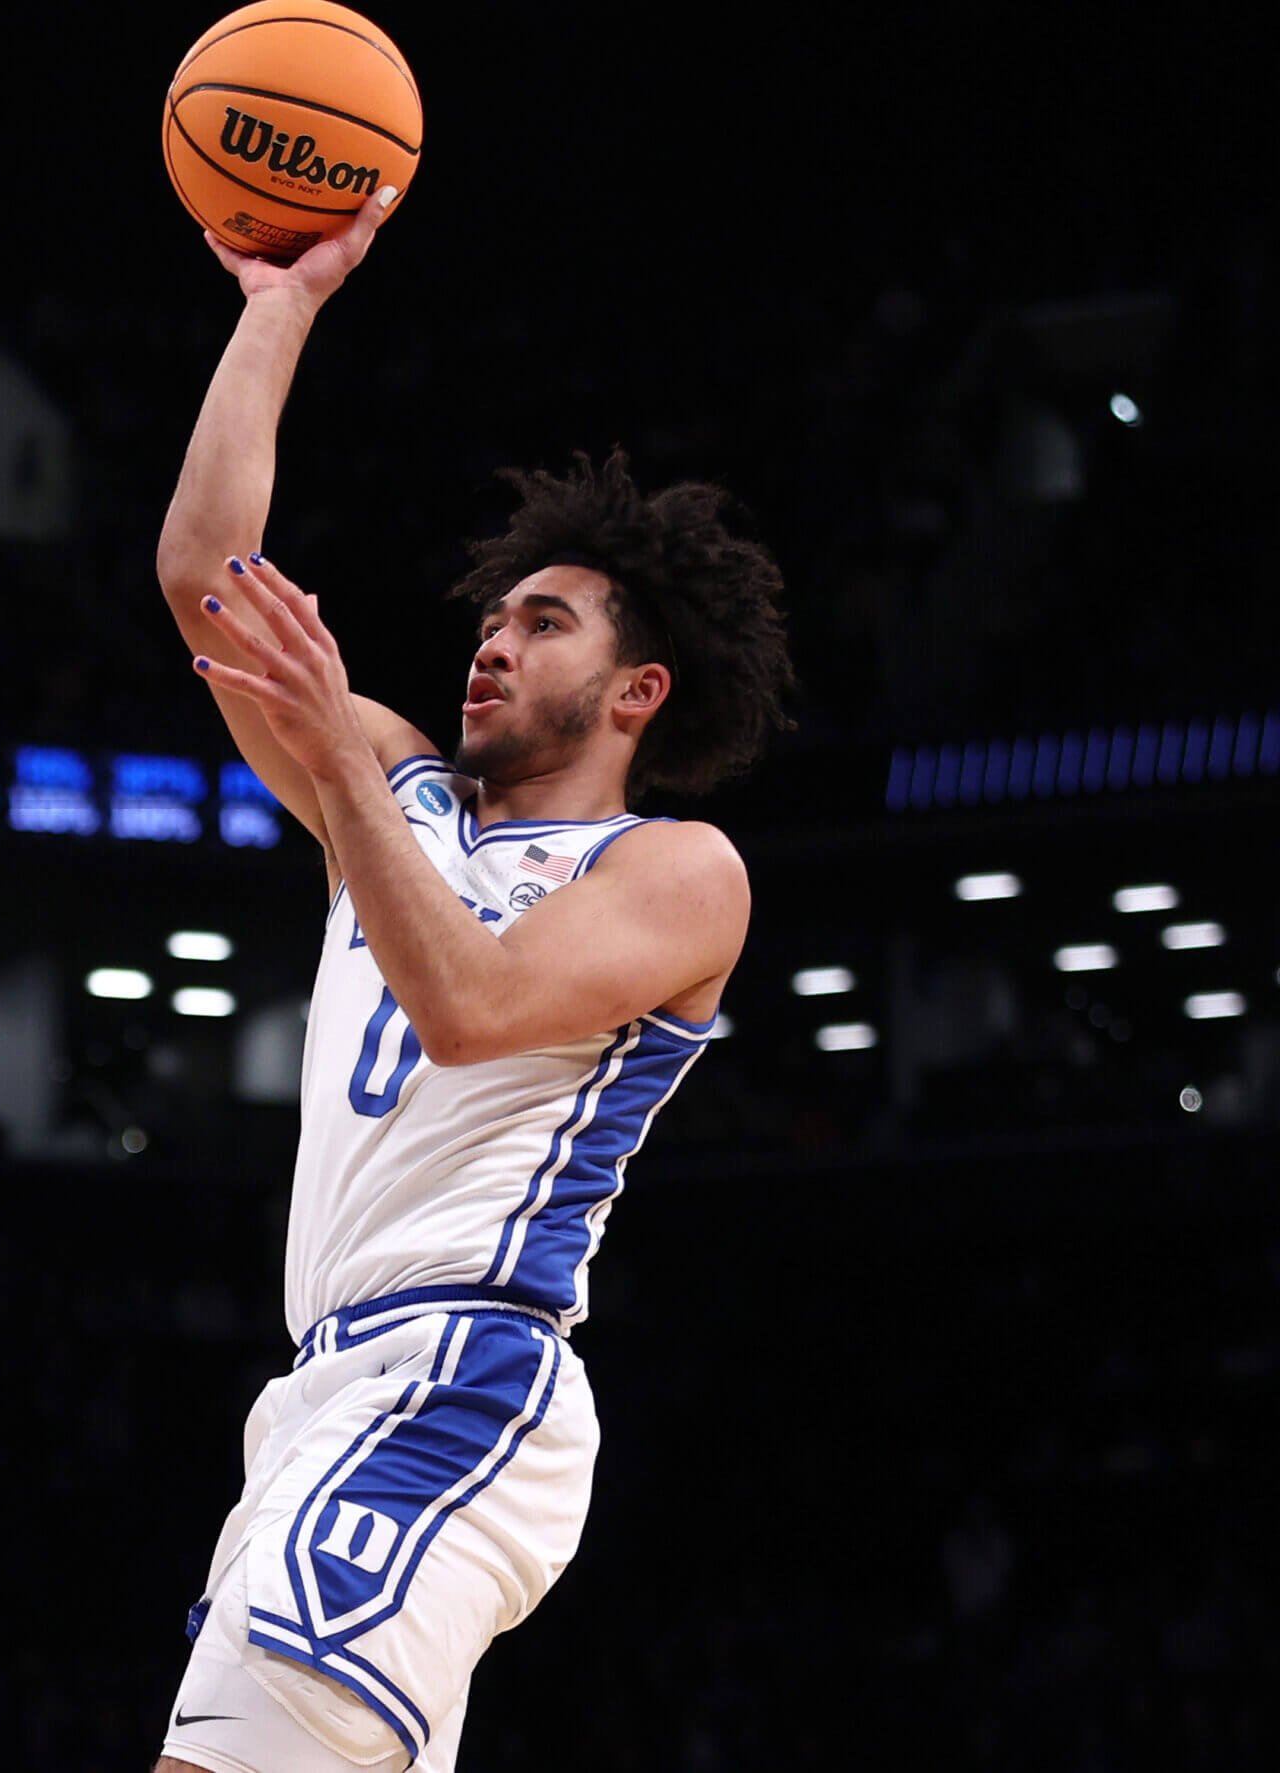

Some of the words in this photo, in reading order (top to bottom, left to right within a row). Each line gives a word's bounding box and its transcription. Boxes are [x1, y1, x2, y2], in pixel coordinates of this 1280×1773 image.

[221, 106, 380, 196] Wilson
[270, 175, 296, 189] EVO
[297, 185, 323, 197] NXT
[420, 786, 444, 814] NCAA
[348, 985, 423, 1118] 0
[316, 1499, 400, 1575] D
